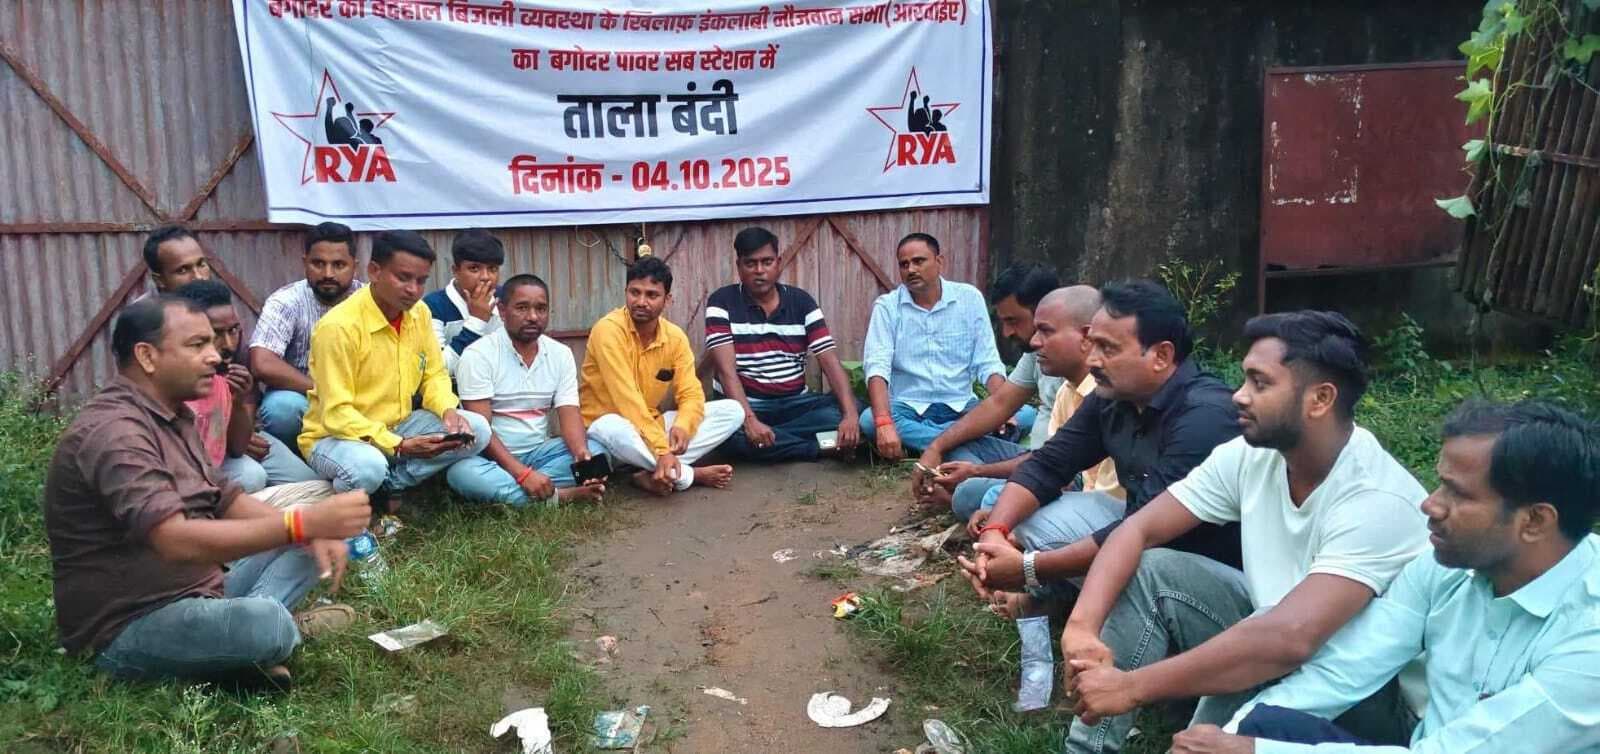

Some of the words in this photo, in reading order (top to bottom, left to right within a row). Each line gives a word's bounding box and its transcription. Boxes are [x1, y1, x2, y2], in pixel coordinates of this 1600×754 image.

[519, 8, 596, 31] व्यवस्था
[600, 8, 617, 31] के
[698, 6, 769, 33] इंकलाबी
[772, 4, 844, 28] नौजवान
[511, 48, 540, 71] का
[549, 45, 610, 72] बगोदर
[616, 50, 660, 72] पावर
[664, 50, 696, 72] सब
[699, 45, 755, 72] स्टेशन
[758, 43, 780, 70] में
[557, 94, 661, 139] ताला
[667, 79, 739, 136] बंदी
[314, 145, 397, 183] RYA
[896, 133, 957, 167] RYA
[508, 154, 604, 195] दिनांक
[631, 155, 792, 192] 04.10.2025
